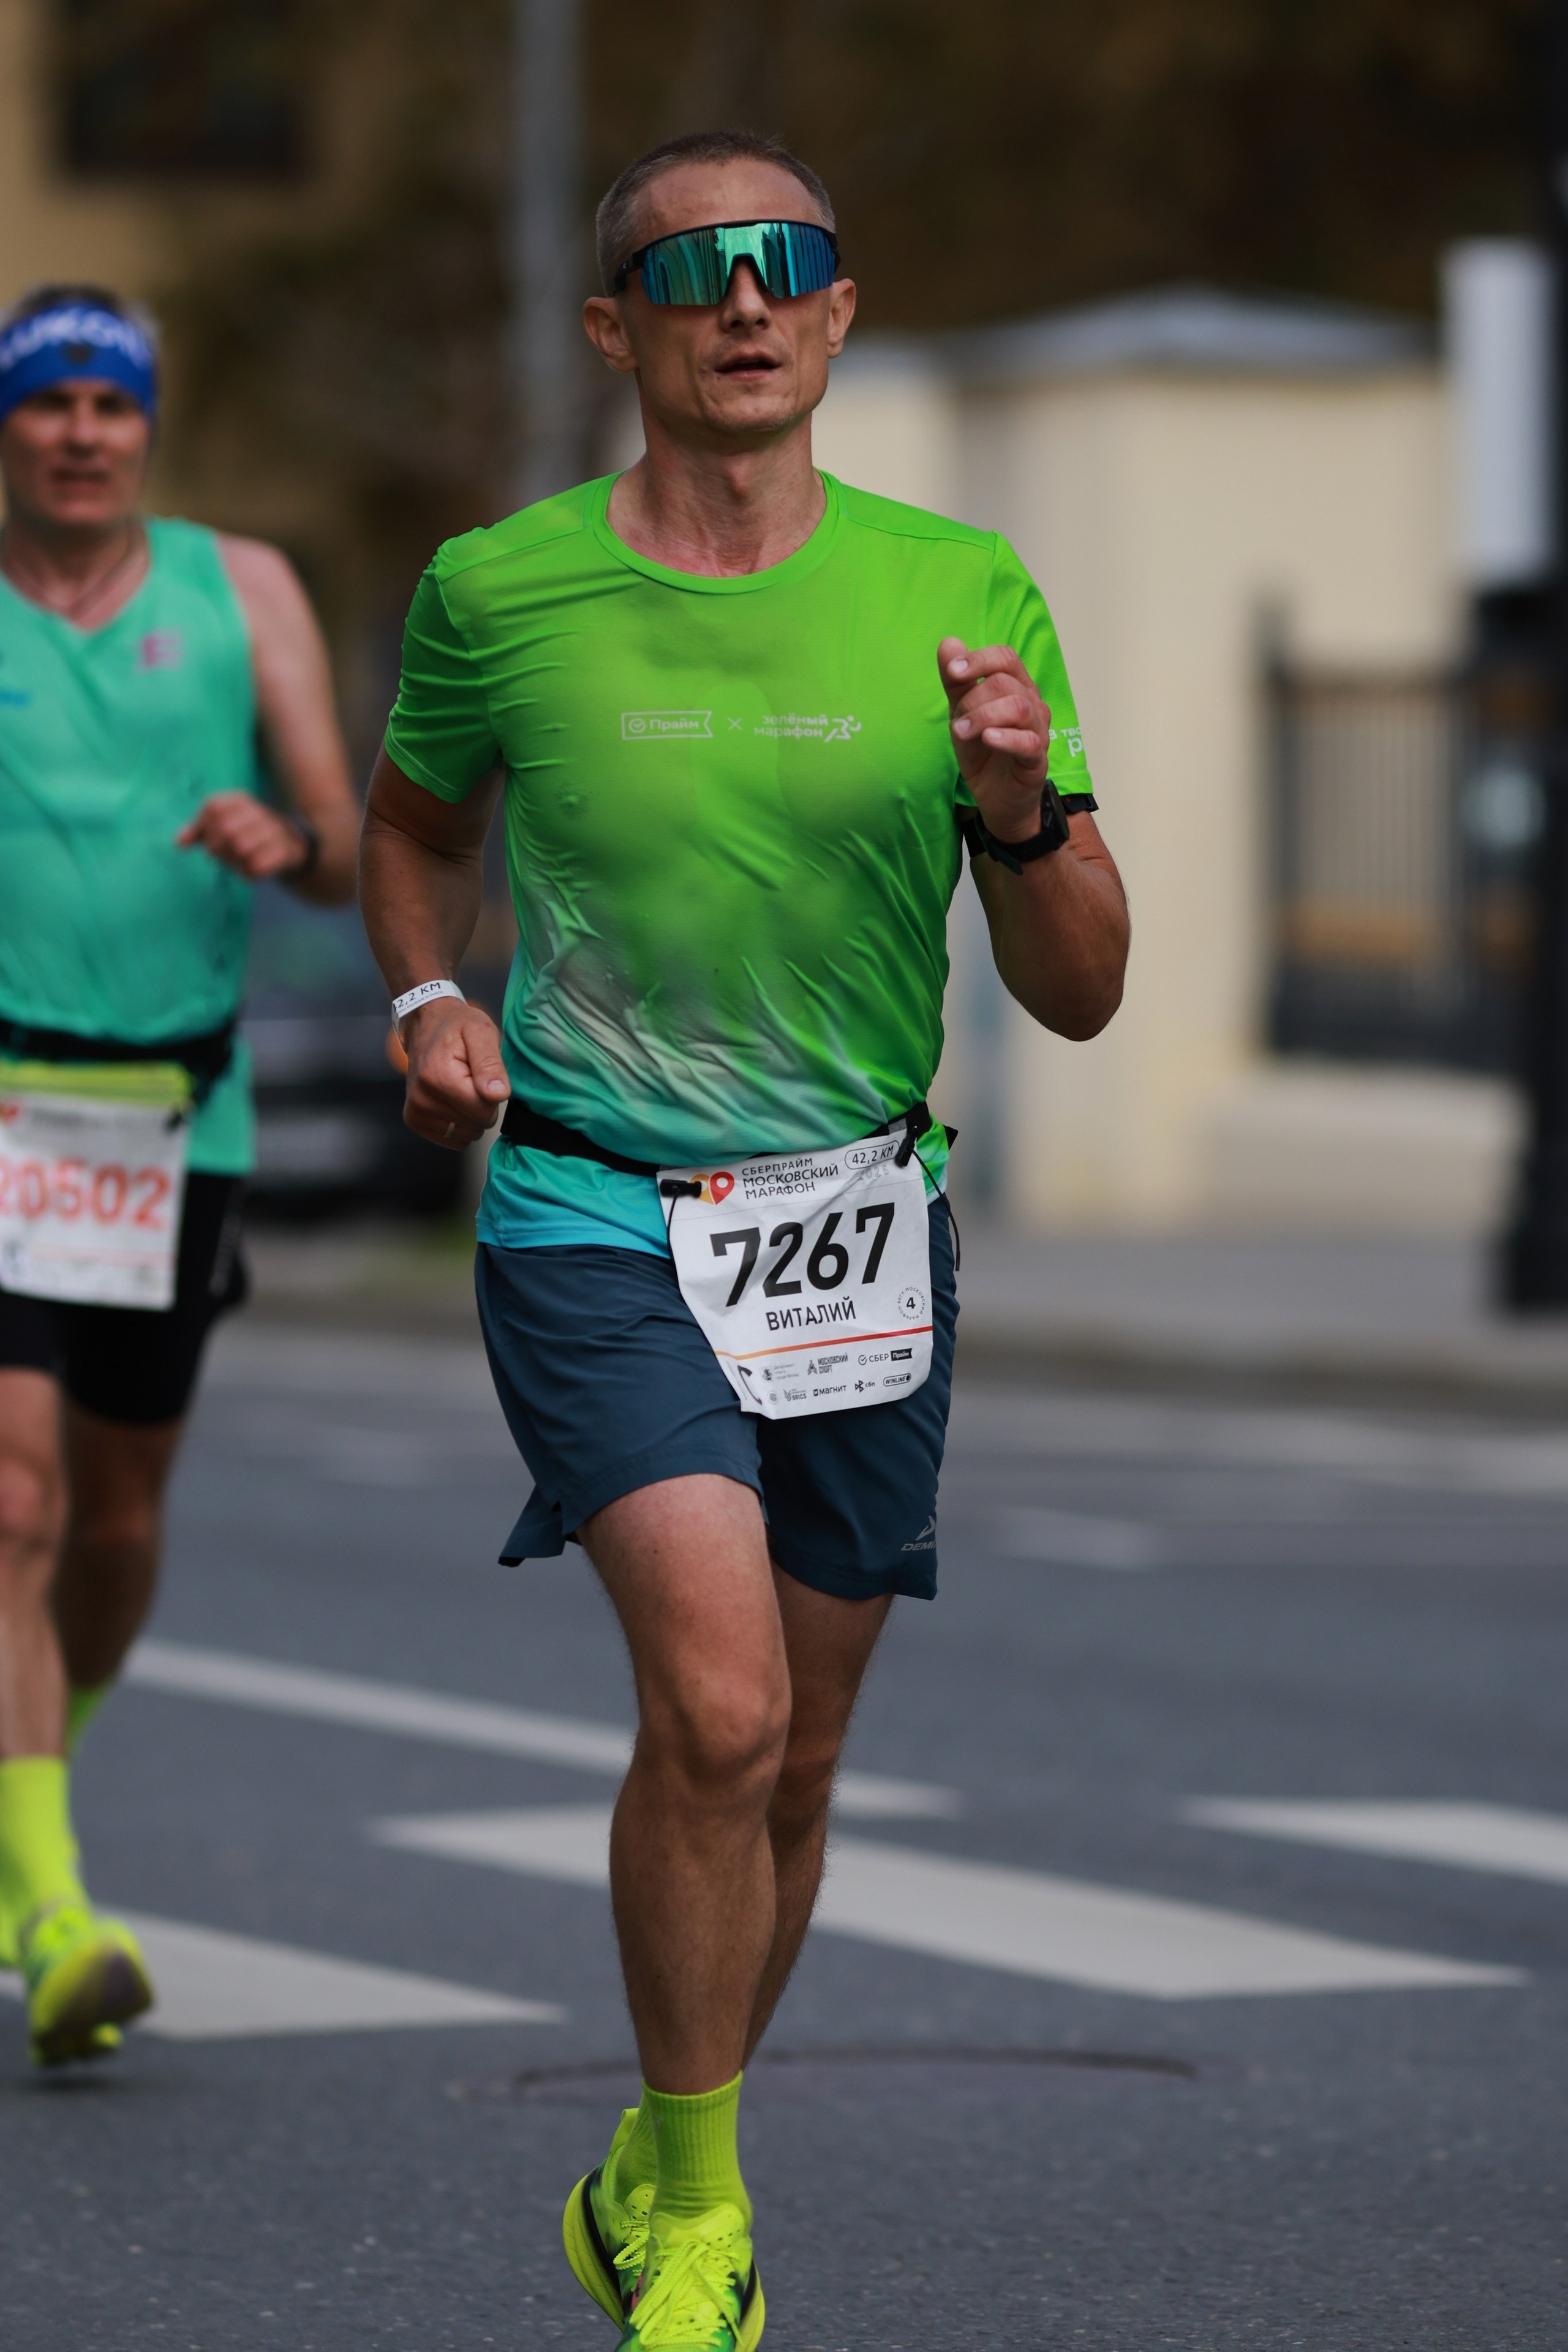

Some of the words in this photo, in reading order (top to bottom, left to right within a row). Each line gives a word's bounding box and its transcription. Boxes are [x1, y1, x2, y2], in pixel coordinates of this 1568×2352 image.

[650, 717, 699, 731] Прайм
[754, 725, 823, 739] марафон
[852, 1150, 878, 1164] 42,2
[742, 1158, 813, 1176] СБЕРПРАЙМ
[743, 1163, 839, 1188] МОСКОВСКИЙ
[745, 1182, 815, 1200] МАРАФОН
[709, 1202, 895, 1307] 7267
[906, 1297, 916, 1309] 4
[766, 1295, 856, 1331] ВИТАЛИЙ
[817, 1352, 848, 1366] МОСКОВСКИЙ
[869, 1353, 889, 1363] СБЕР
[818, 1365, 833, 1374] СПОРТ
